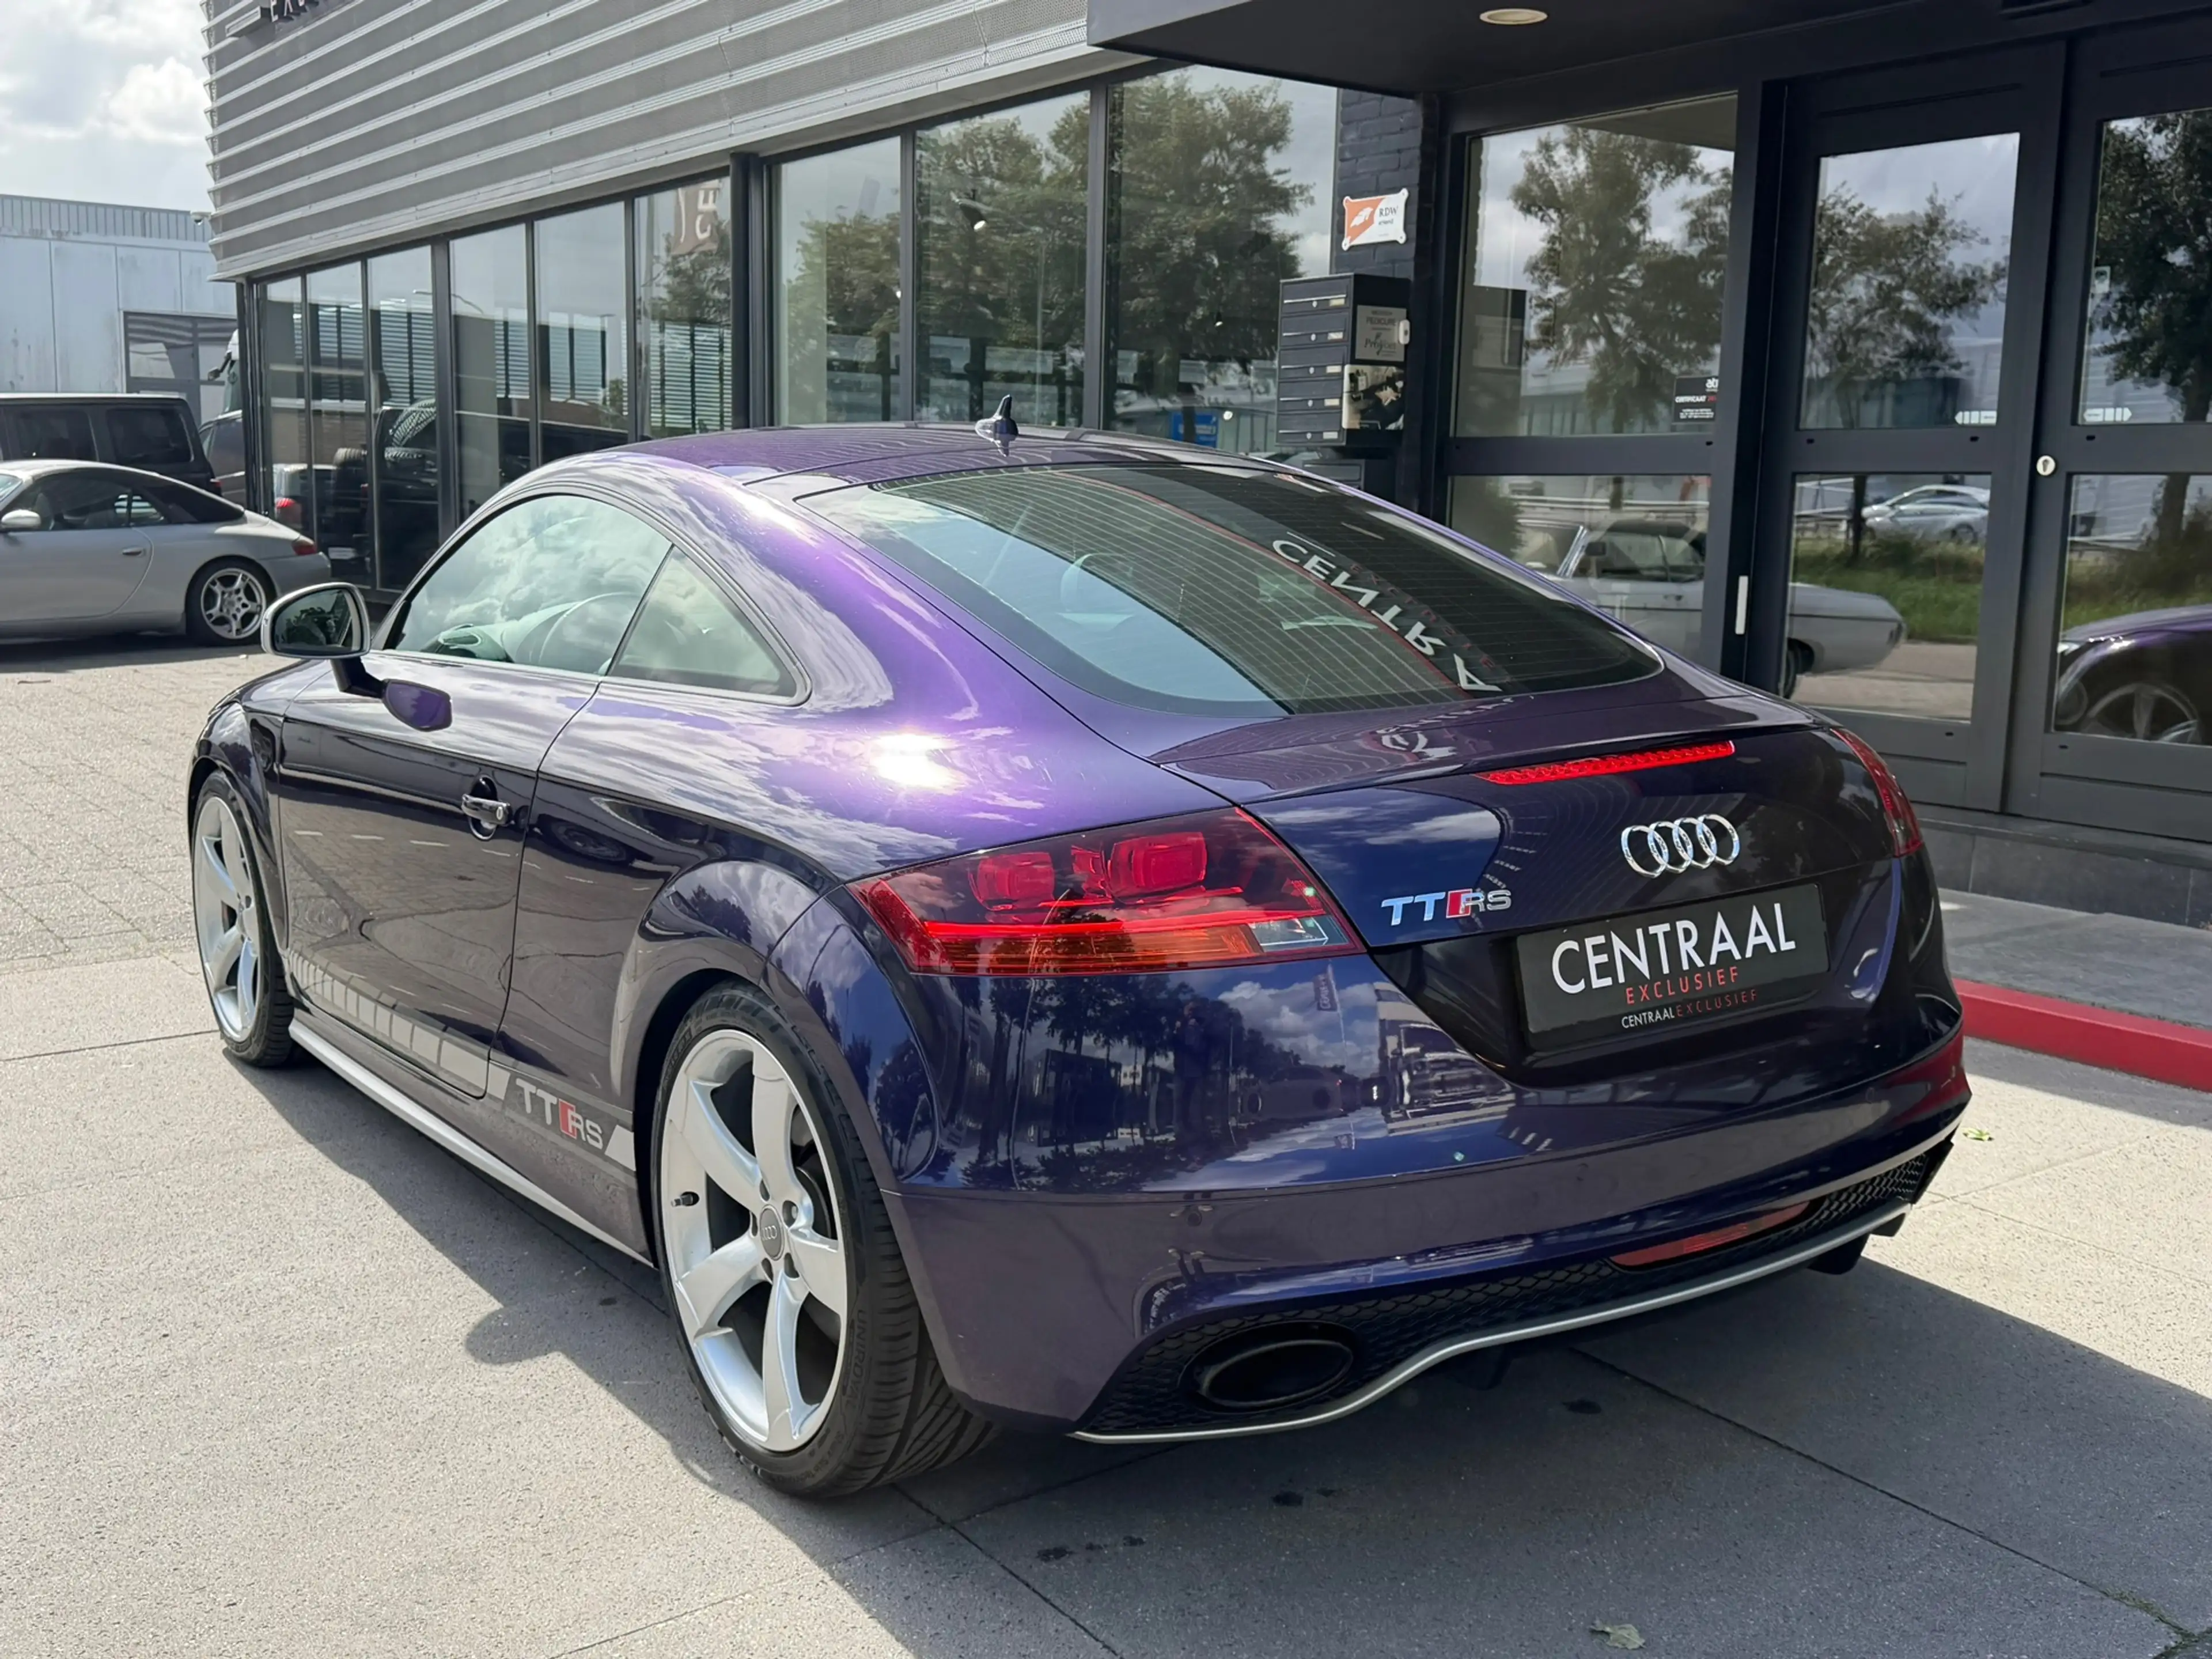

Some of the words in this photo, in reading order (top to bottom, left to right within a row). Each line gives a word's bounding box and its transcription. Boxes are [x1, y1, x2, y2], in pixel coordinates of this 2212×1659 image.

[1379, 206, 1398, 217] RDW
[1552, 903, 1796, 994] CENTRAAL
[1626, 966, 1739, 1005] EXCLUSIEF
[845, 1309, 868, 1410] UNIROYAL
